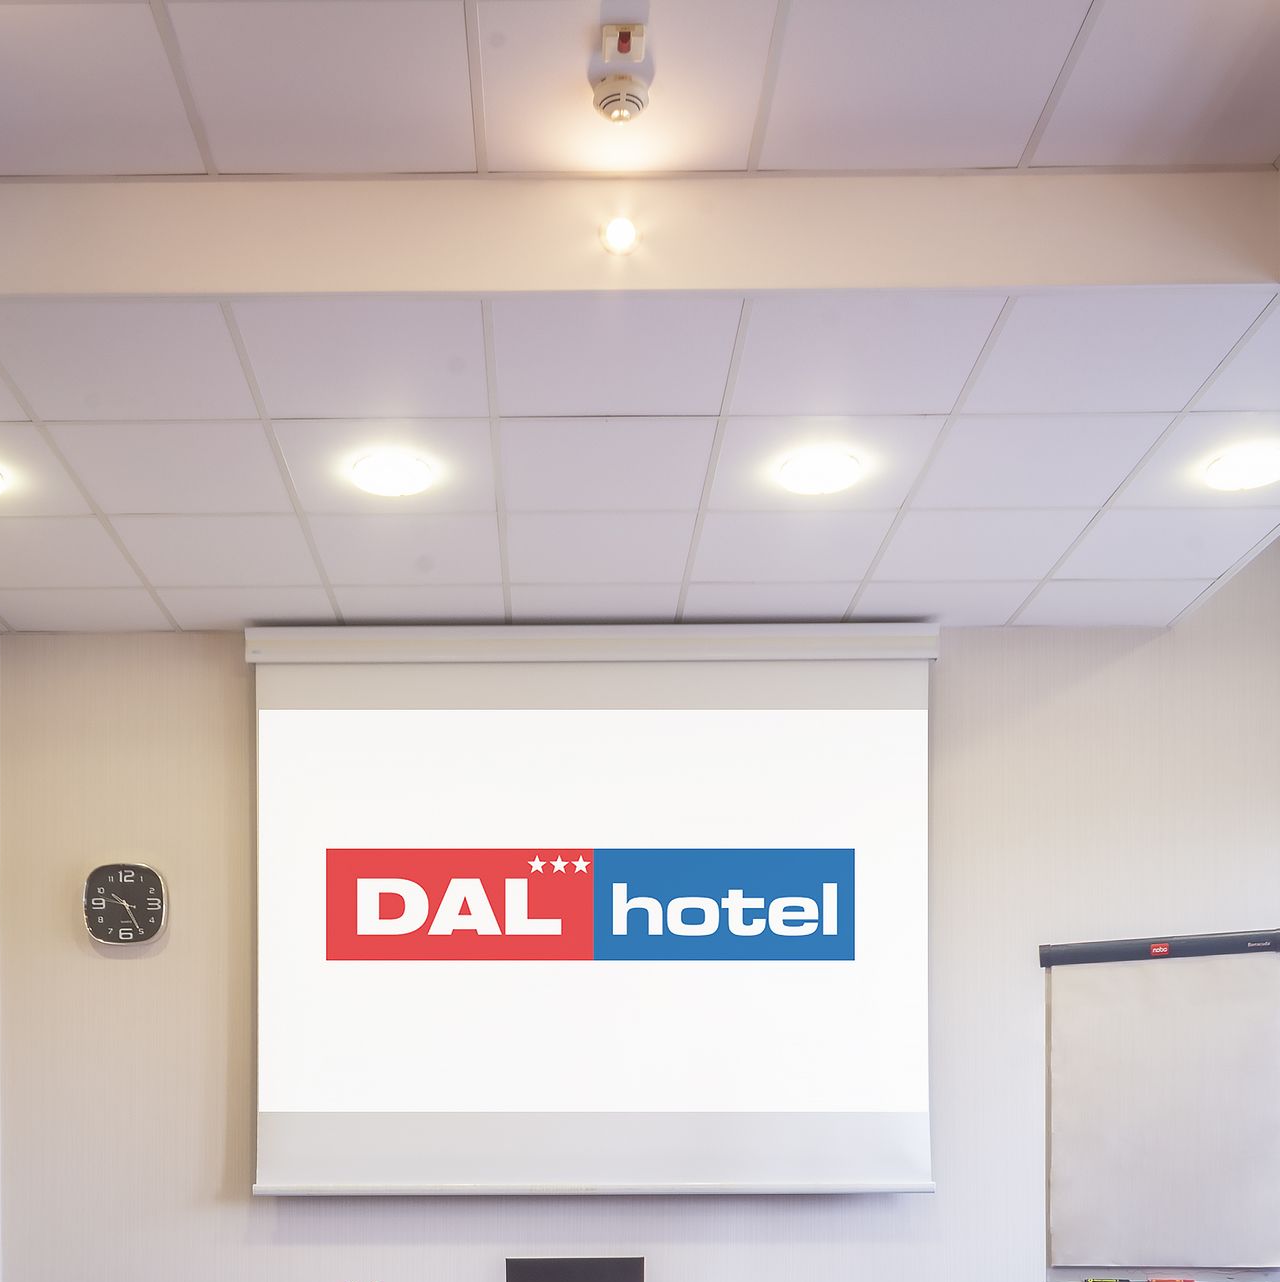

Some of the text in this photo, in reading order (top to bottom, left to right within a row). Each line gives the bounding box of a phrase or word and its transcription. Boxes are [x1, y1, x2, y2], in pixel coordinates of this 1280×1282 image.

[118, 870, 135, 883] 12
[91, 897, 106, 910] 9
[146, 897, 162, 911] 3
[356, 878, 838, 937] DAL hotel
[98, 916, 104, 924] 8
[108, 927, 114, 935] 7
[119, 928, 133, 940] 6
[138, 927, 145, 935] 5
